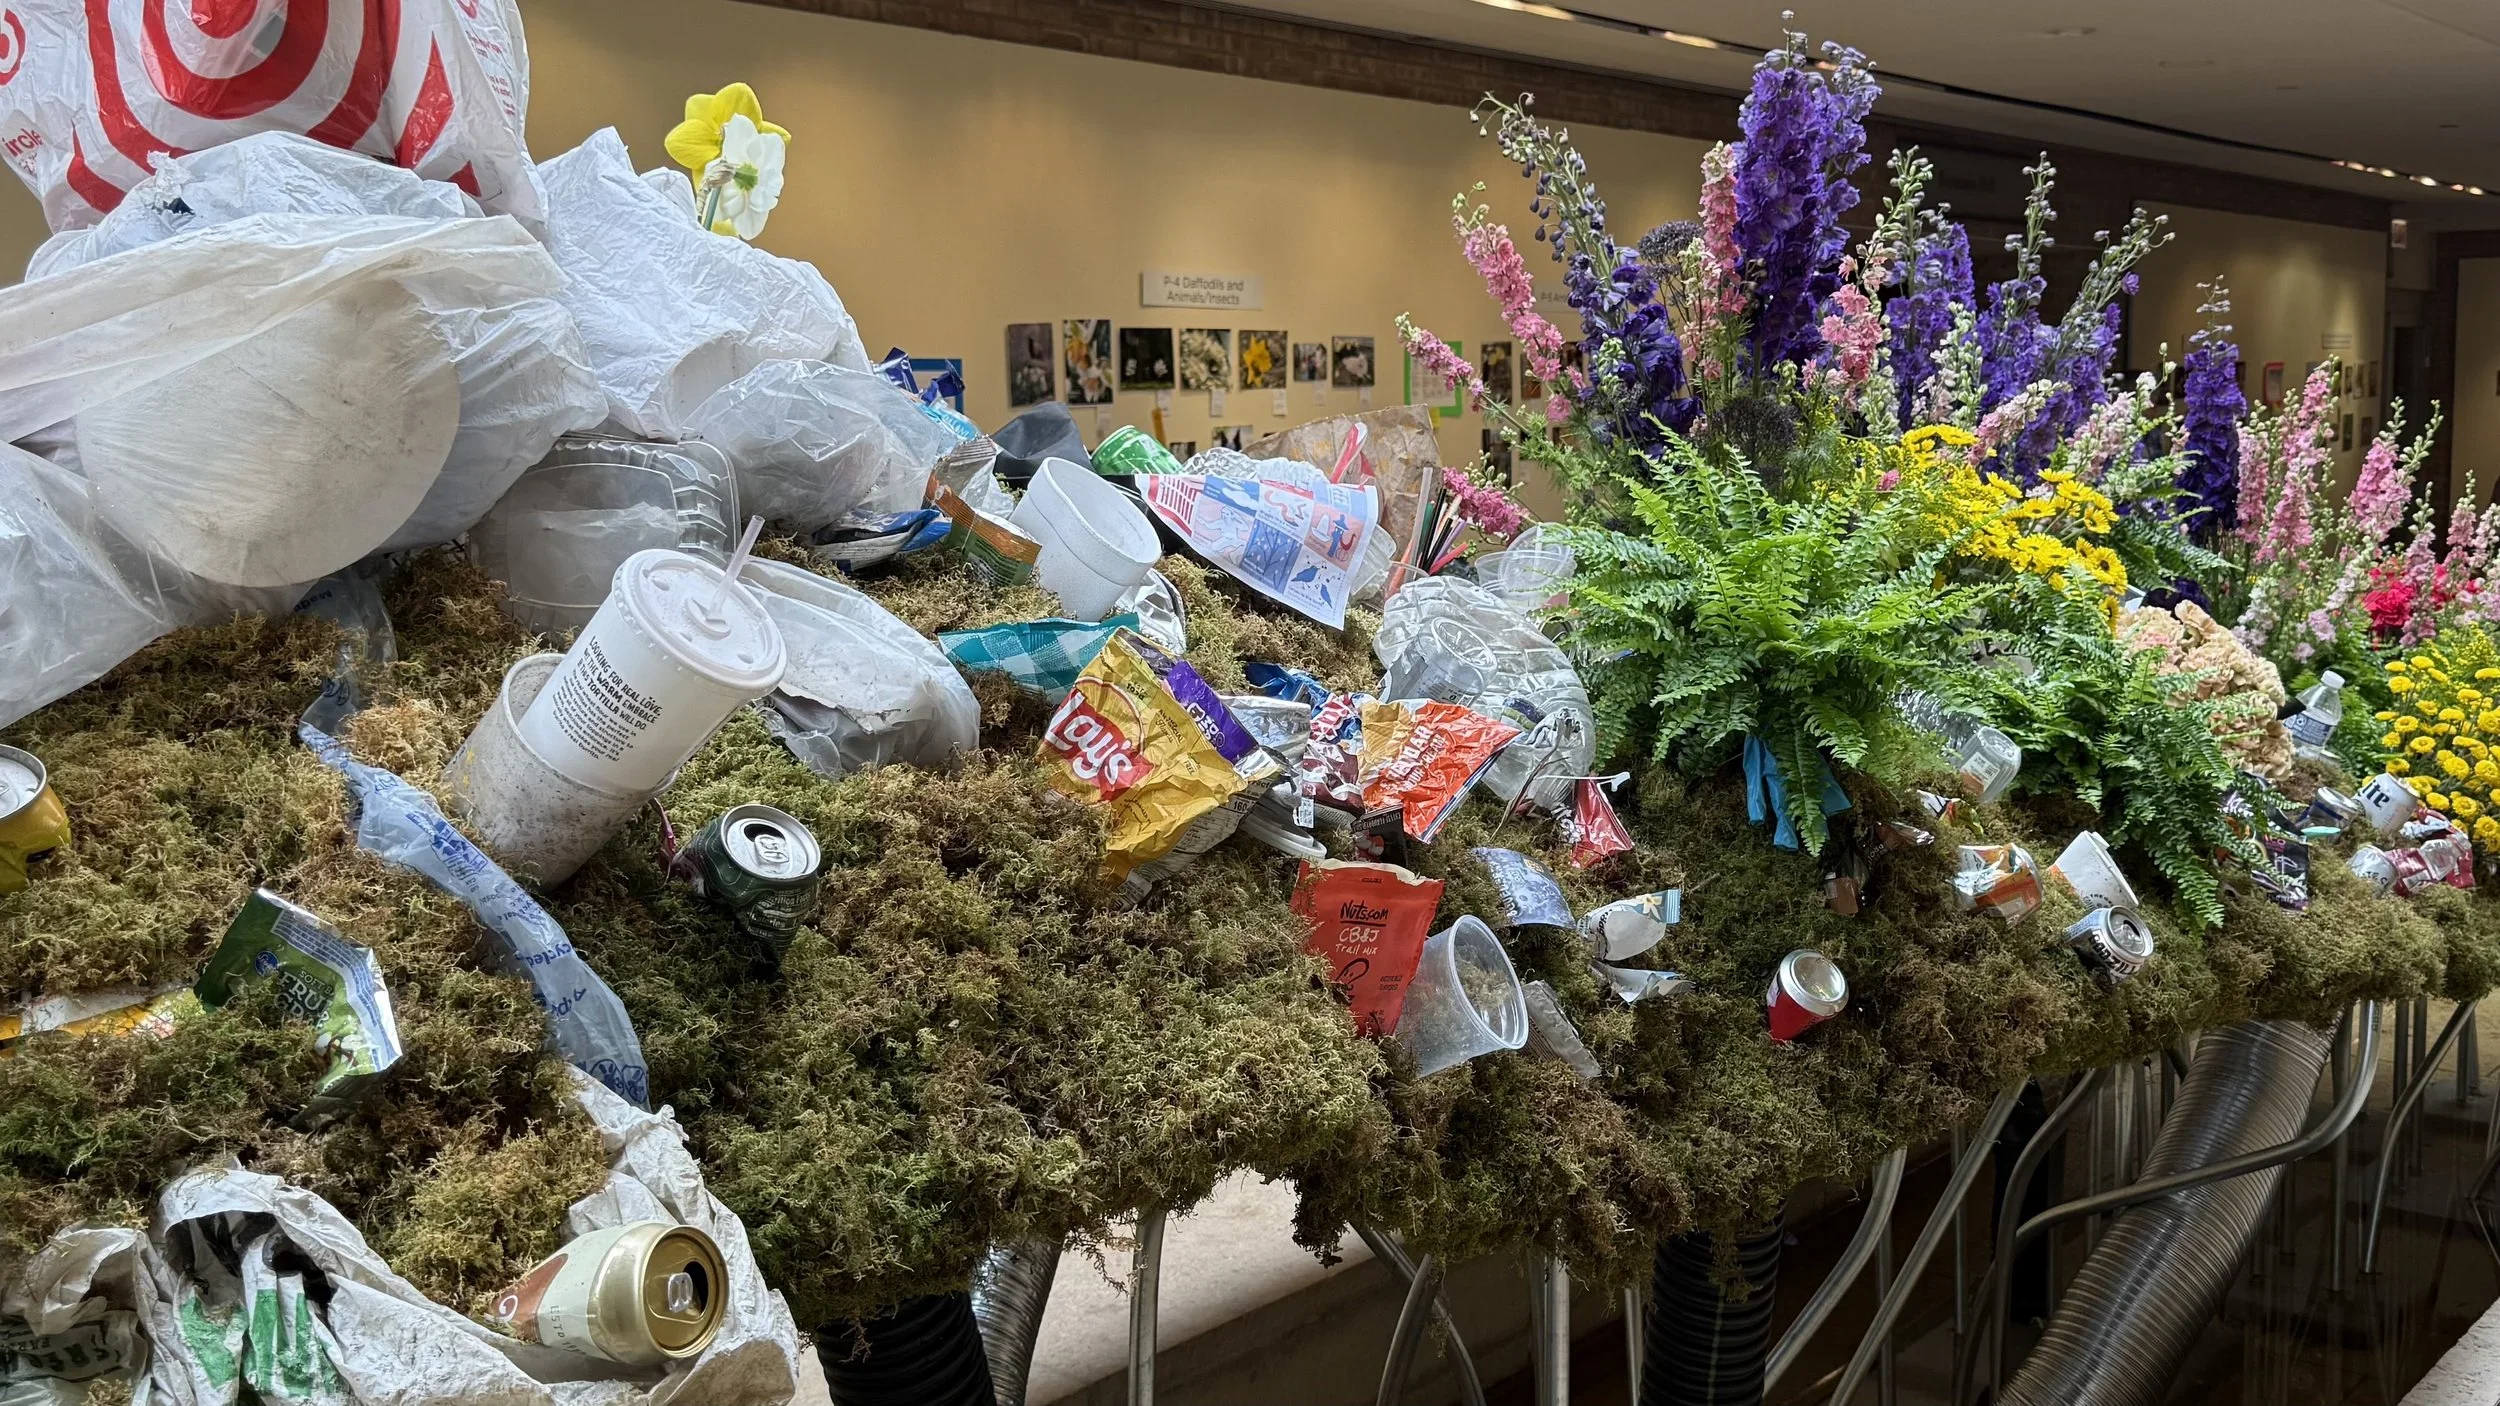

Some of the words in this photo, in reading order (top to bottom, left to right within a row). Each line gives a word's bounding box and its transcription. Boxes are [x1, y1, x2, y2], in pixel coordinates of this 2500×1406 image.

[1167, 290, 1240, 305] Animals/Insects
[1182, 276, 1225, 290] Daffodils
[1227, 279, 1244, 291] and
[589, 636, 611, 673] LOOKING
[608, 671, 623, 688] FOR
[621, 684, 642, 702] REAL
[580, 664, 590, 681] THIS
[587, 678, 620, 714] TORTILLA
[619, 711, 635, 725] WILL
[588, 658, 599, 676] THE
[596, 672, 623, 703] WARM
[622, 699, 657, 724] EMBRACE
[574, 713, 586, 725] your
[582, 691, 596, 707] wheat
[595, 706, 608, 719] flour
[618, 725, 629, 733] use
[587, 707, 596, 717] has
[597, 716, 606, 725] the
[607, 724, 629, 740] perfect
[563, 716, 575, 731] what
[573, 729, 591, 746] makes
[591, 745, 605, 754] your
[606, 753, 620, 762] real
[568, 733, 579, 744] real
[588, 717, 599, 727] and
[599, 726, 626, 745] structure
[1045, 692, 1133, 785] Lay's
[2359, 780, 2391, 809] ite
[1339, 926, 1380, 943] CB&J
[1335, 943, 1360, 955] Trail
[299, 970, 326, 989] SOFT
